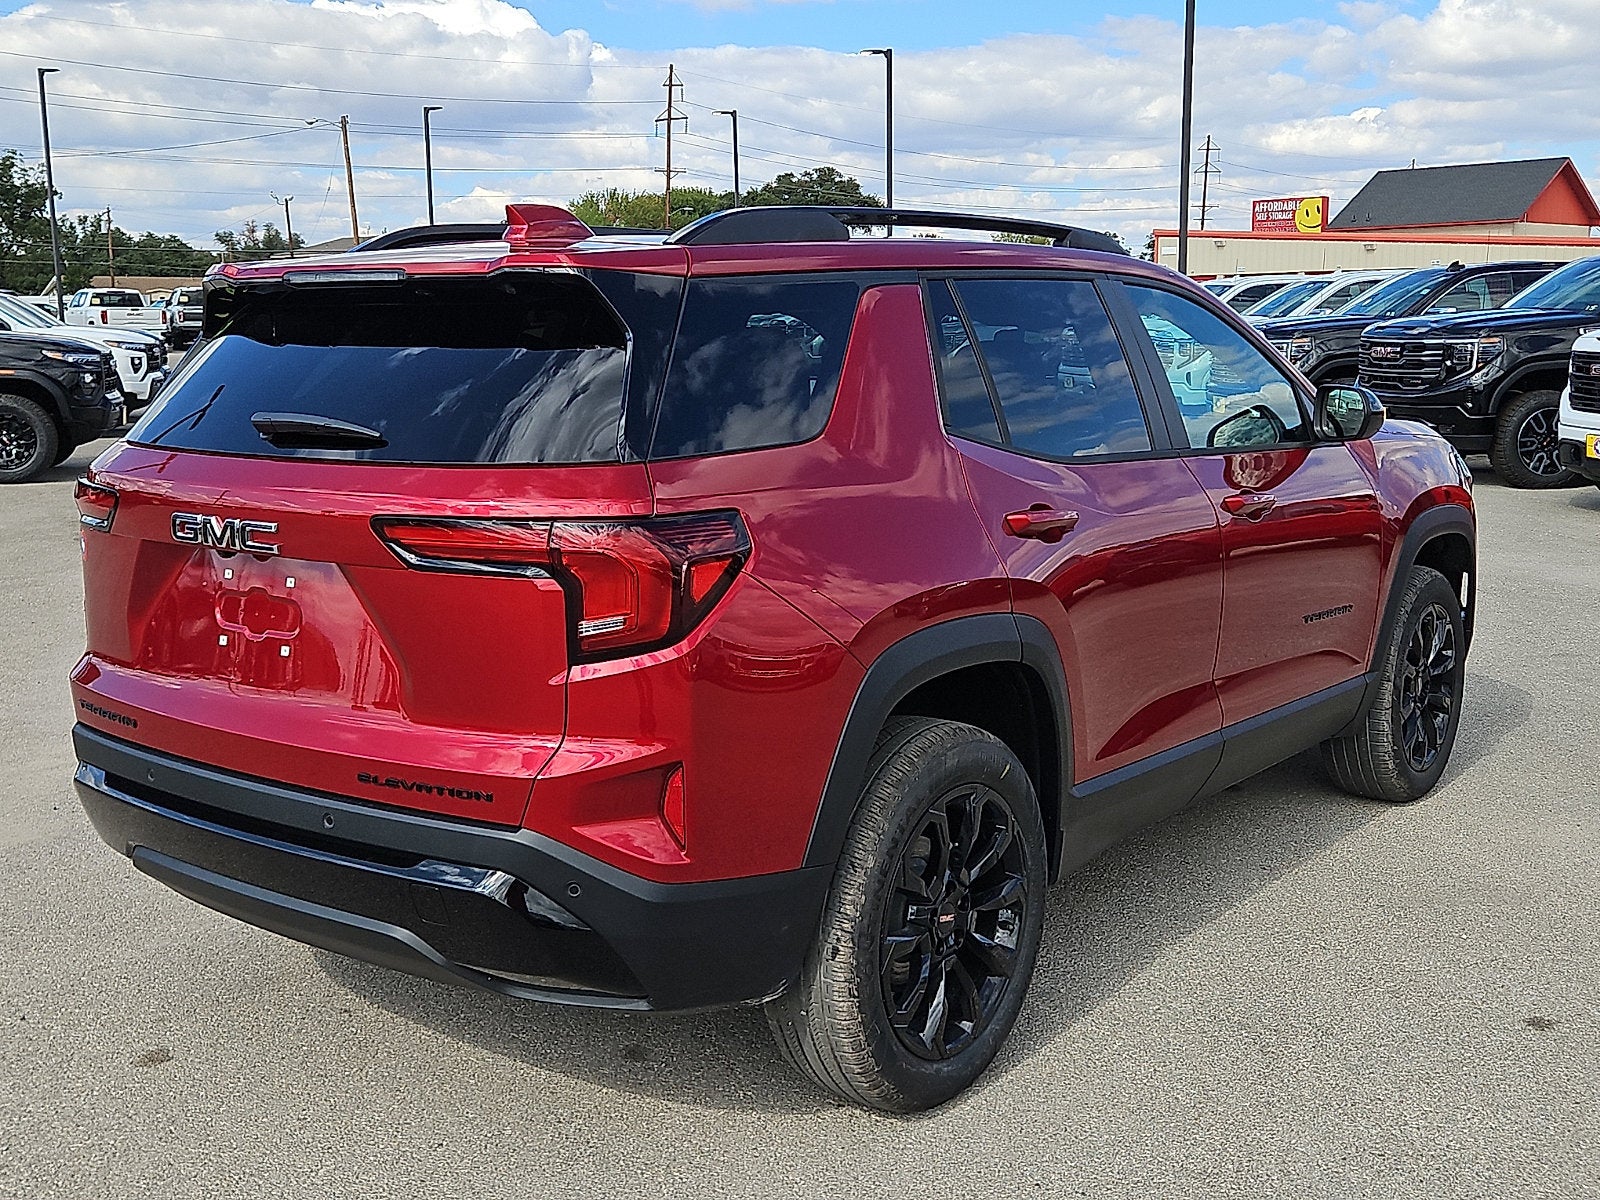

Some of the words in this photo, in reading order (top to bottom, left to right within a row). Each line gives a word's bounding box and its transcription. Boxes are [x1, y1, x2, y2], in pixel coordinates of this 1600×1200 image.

[1255, 200, 1301, 212] AFFORDABLE
[1256, 212, 1268, 221] SELF
[1268, 211, 1293, 220] STORAGE
[1370, 346, 1401, 358] GMC
[171, 511, 281, 554] GMC
[357, 772, 494, 803] ELEVATION
